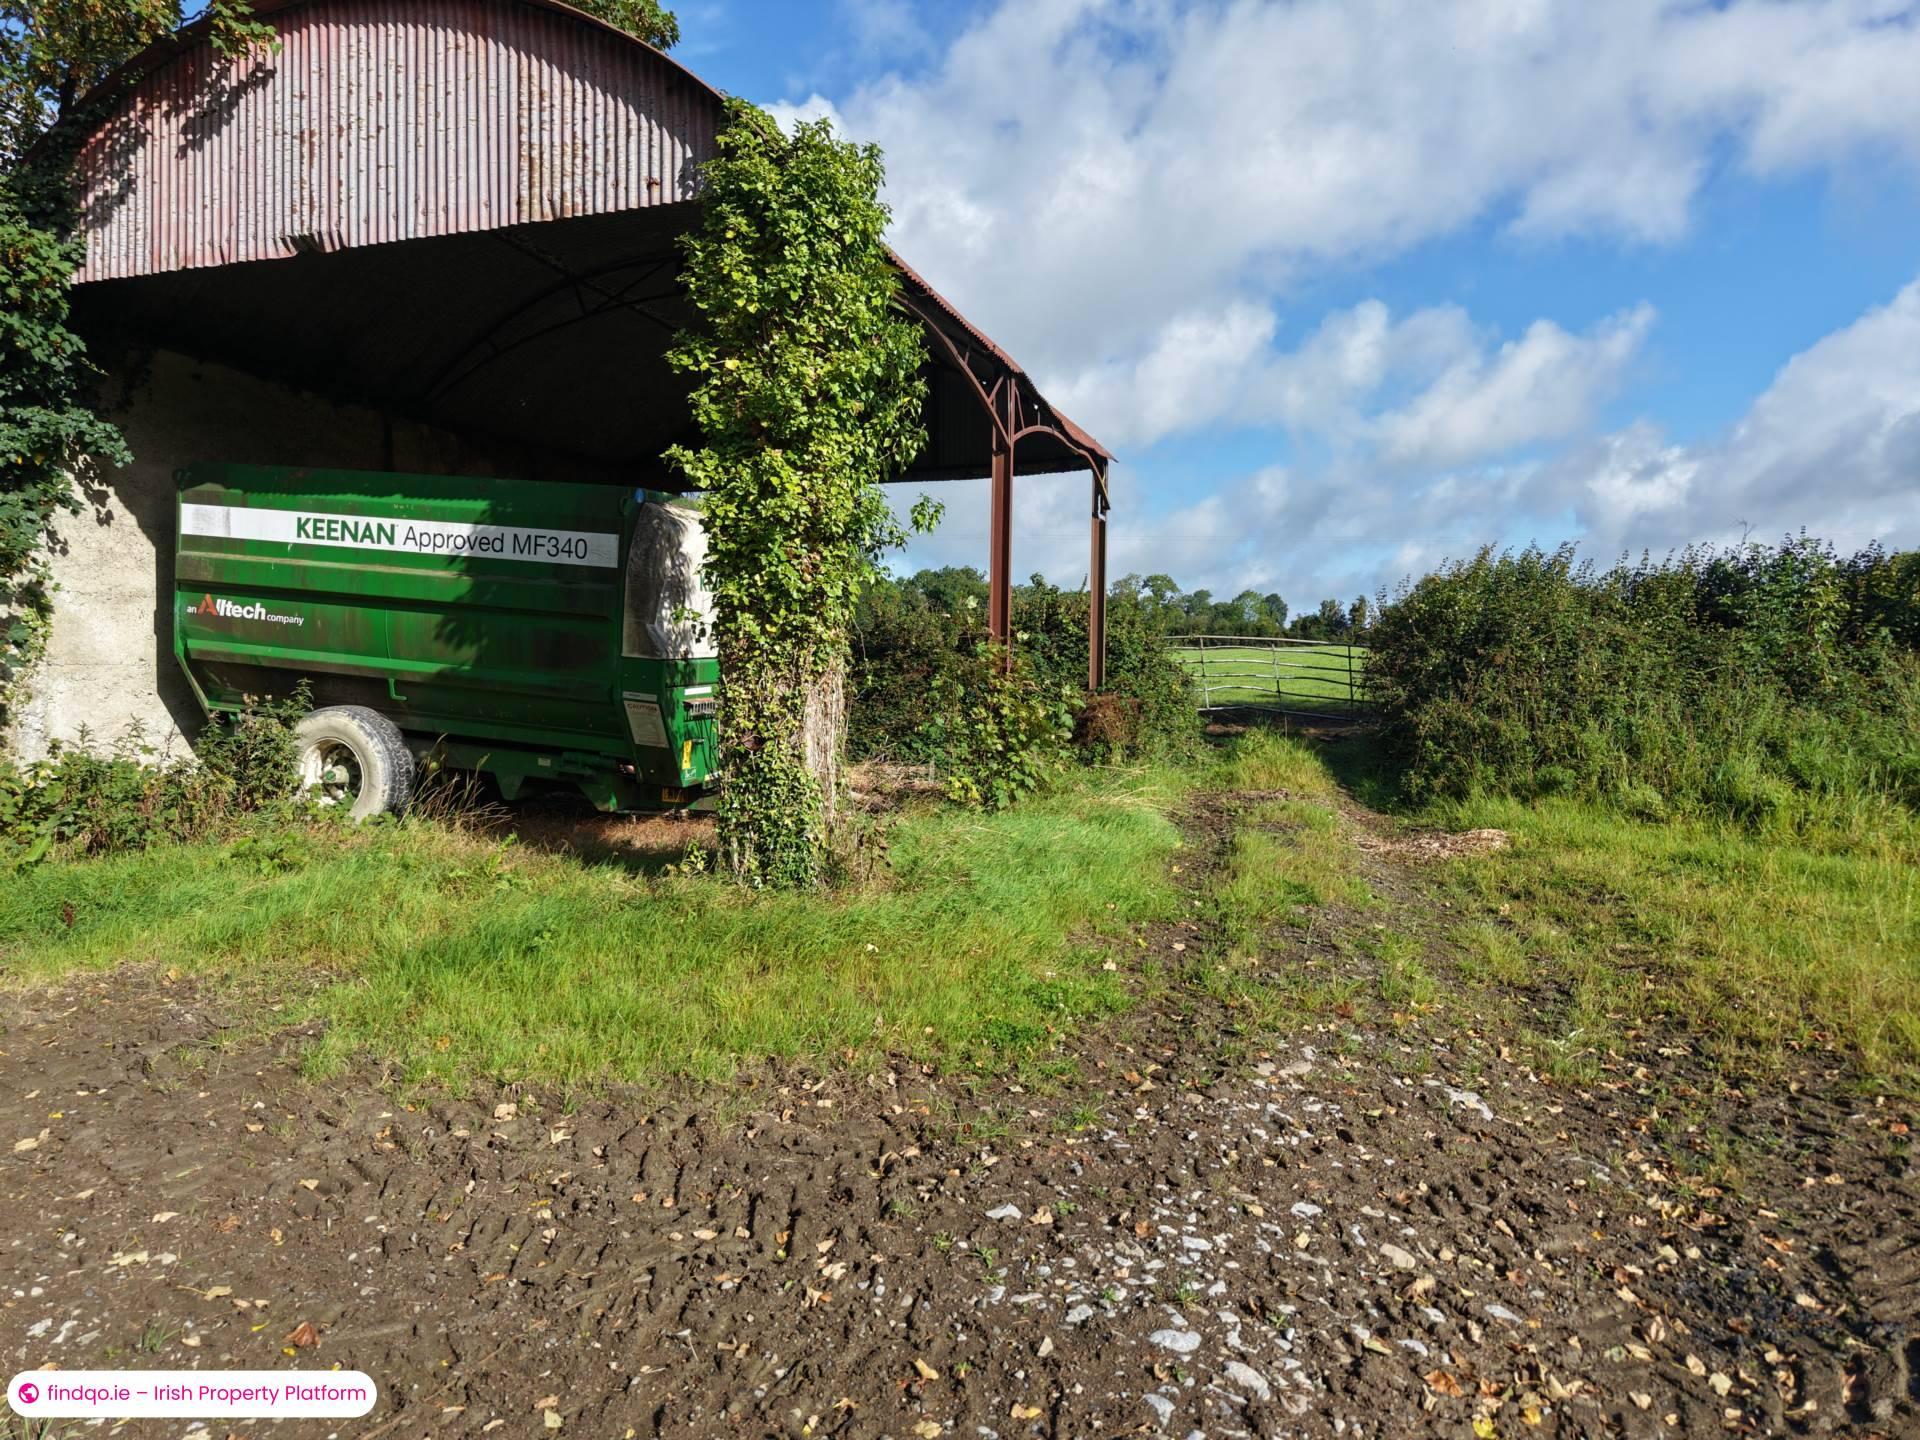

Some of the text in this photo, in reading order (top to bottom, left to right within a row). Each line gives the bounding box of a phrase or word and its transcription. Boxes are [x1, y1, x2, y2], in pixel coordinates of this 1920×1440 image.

[297, 517, 588, 559] KEENAN Approved MF340
[186, 593, 304, 626] an Alltech company
